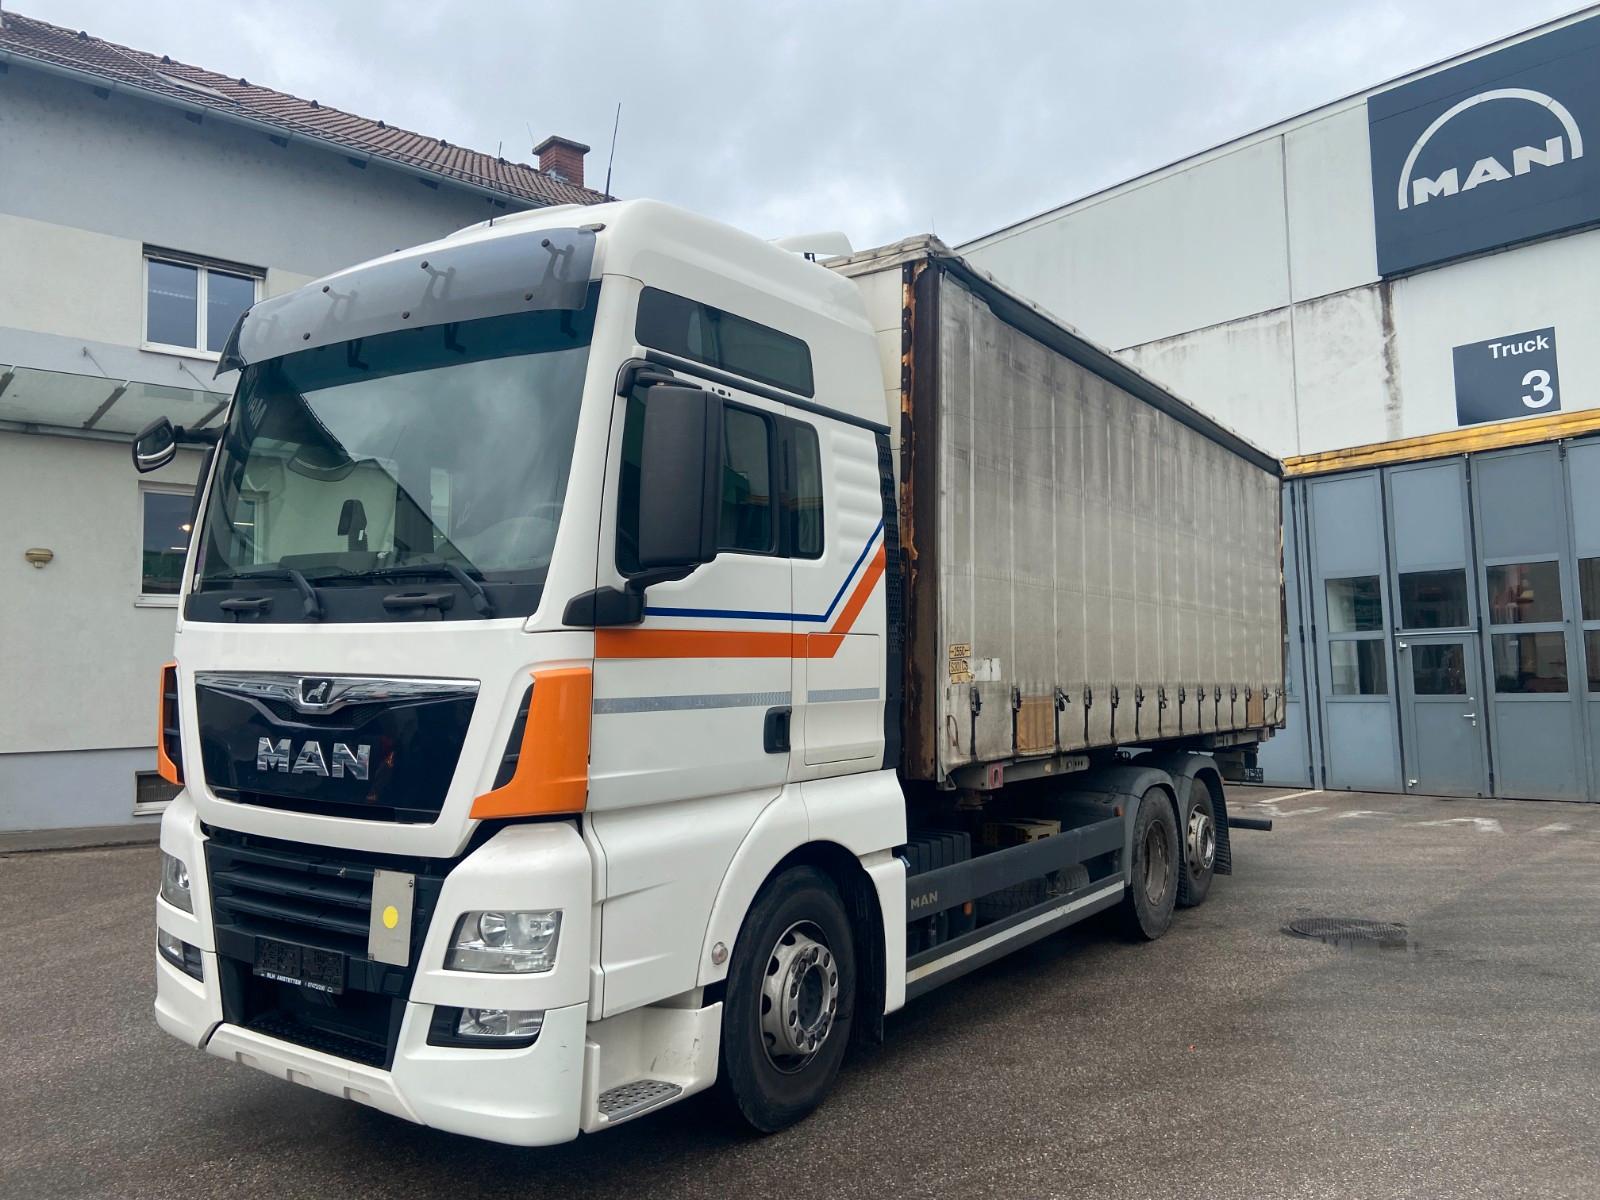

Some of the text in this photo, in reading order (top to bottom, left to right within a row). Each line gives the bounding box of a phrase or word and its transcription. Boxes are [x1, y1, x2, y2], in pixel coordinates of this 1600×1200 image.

[1412, 135, 1565, 206] MAN
[1488, 335, 1549, 359] Truck
[1521, 369, 1554, 409] 3
[256, 736, 371, 780] MAN
[910, 890, 938, 910] MAN
